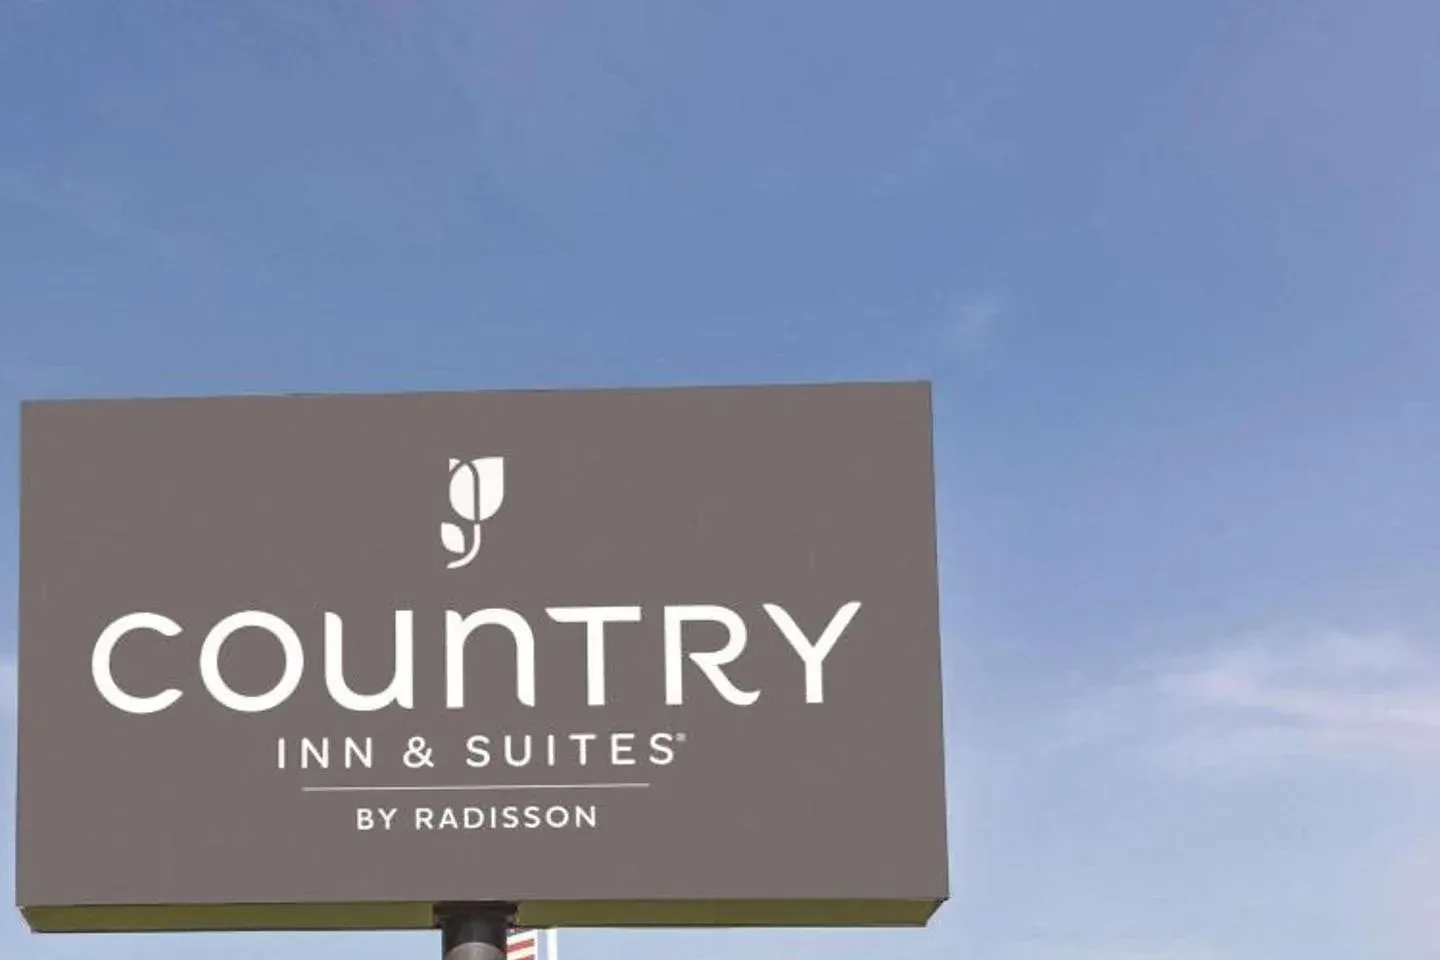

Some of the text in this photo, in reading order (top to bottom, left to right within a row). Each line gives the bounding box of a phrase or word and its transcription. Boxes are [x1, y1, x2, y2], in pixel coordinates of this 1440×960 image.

[278, 736, 372, 769] INN
[402, 735, 435, 769] &
[356, 805, 596, 831] BY RADISSON
